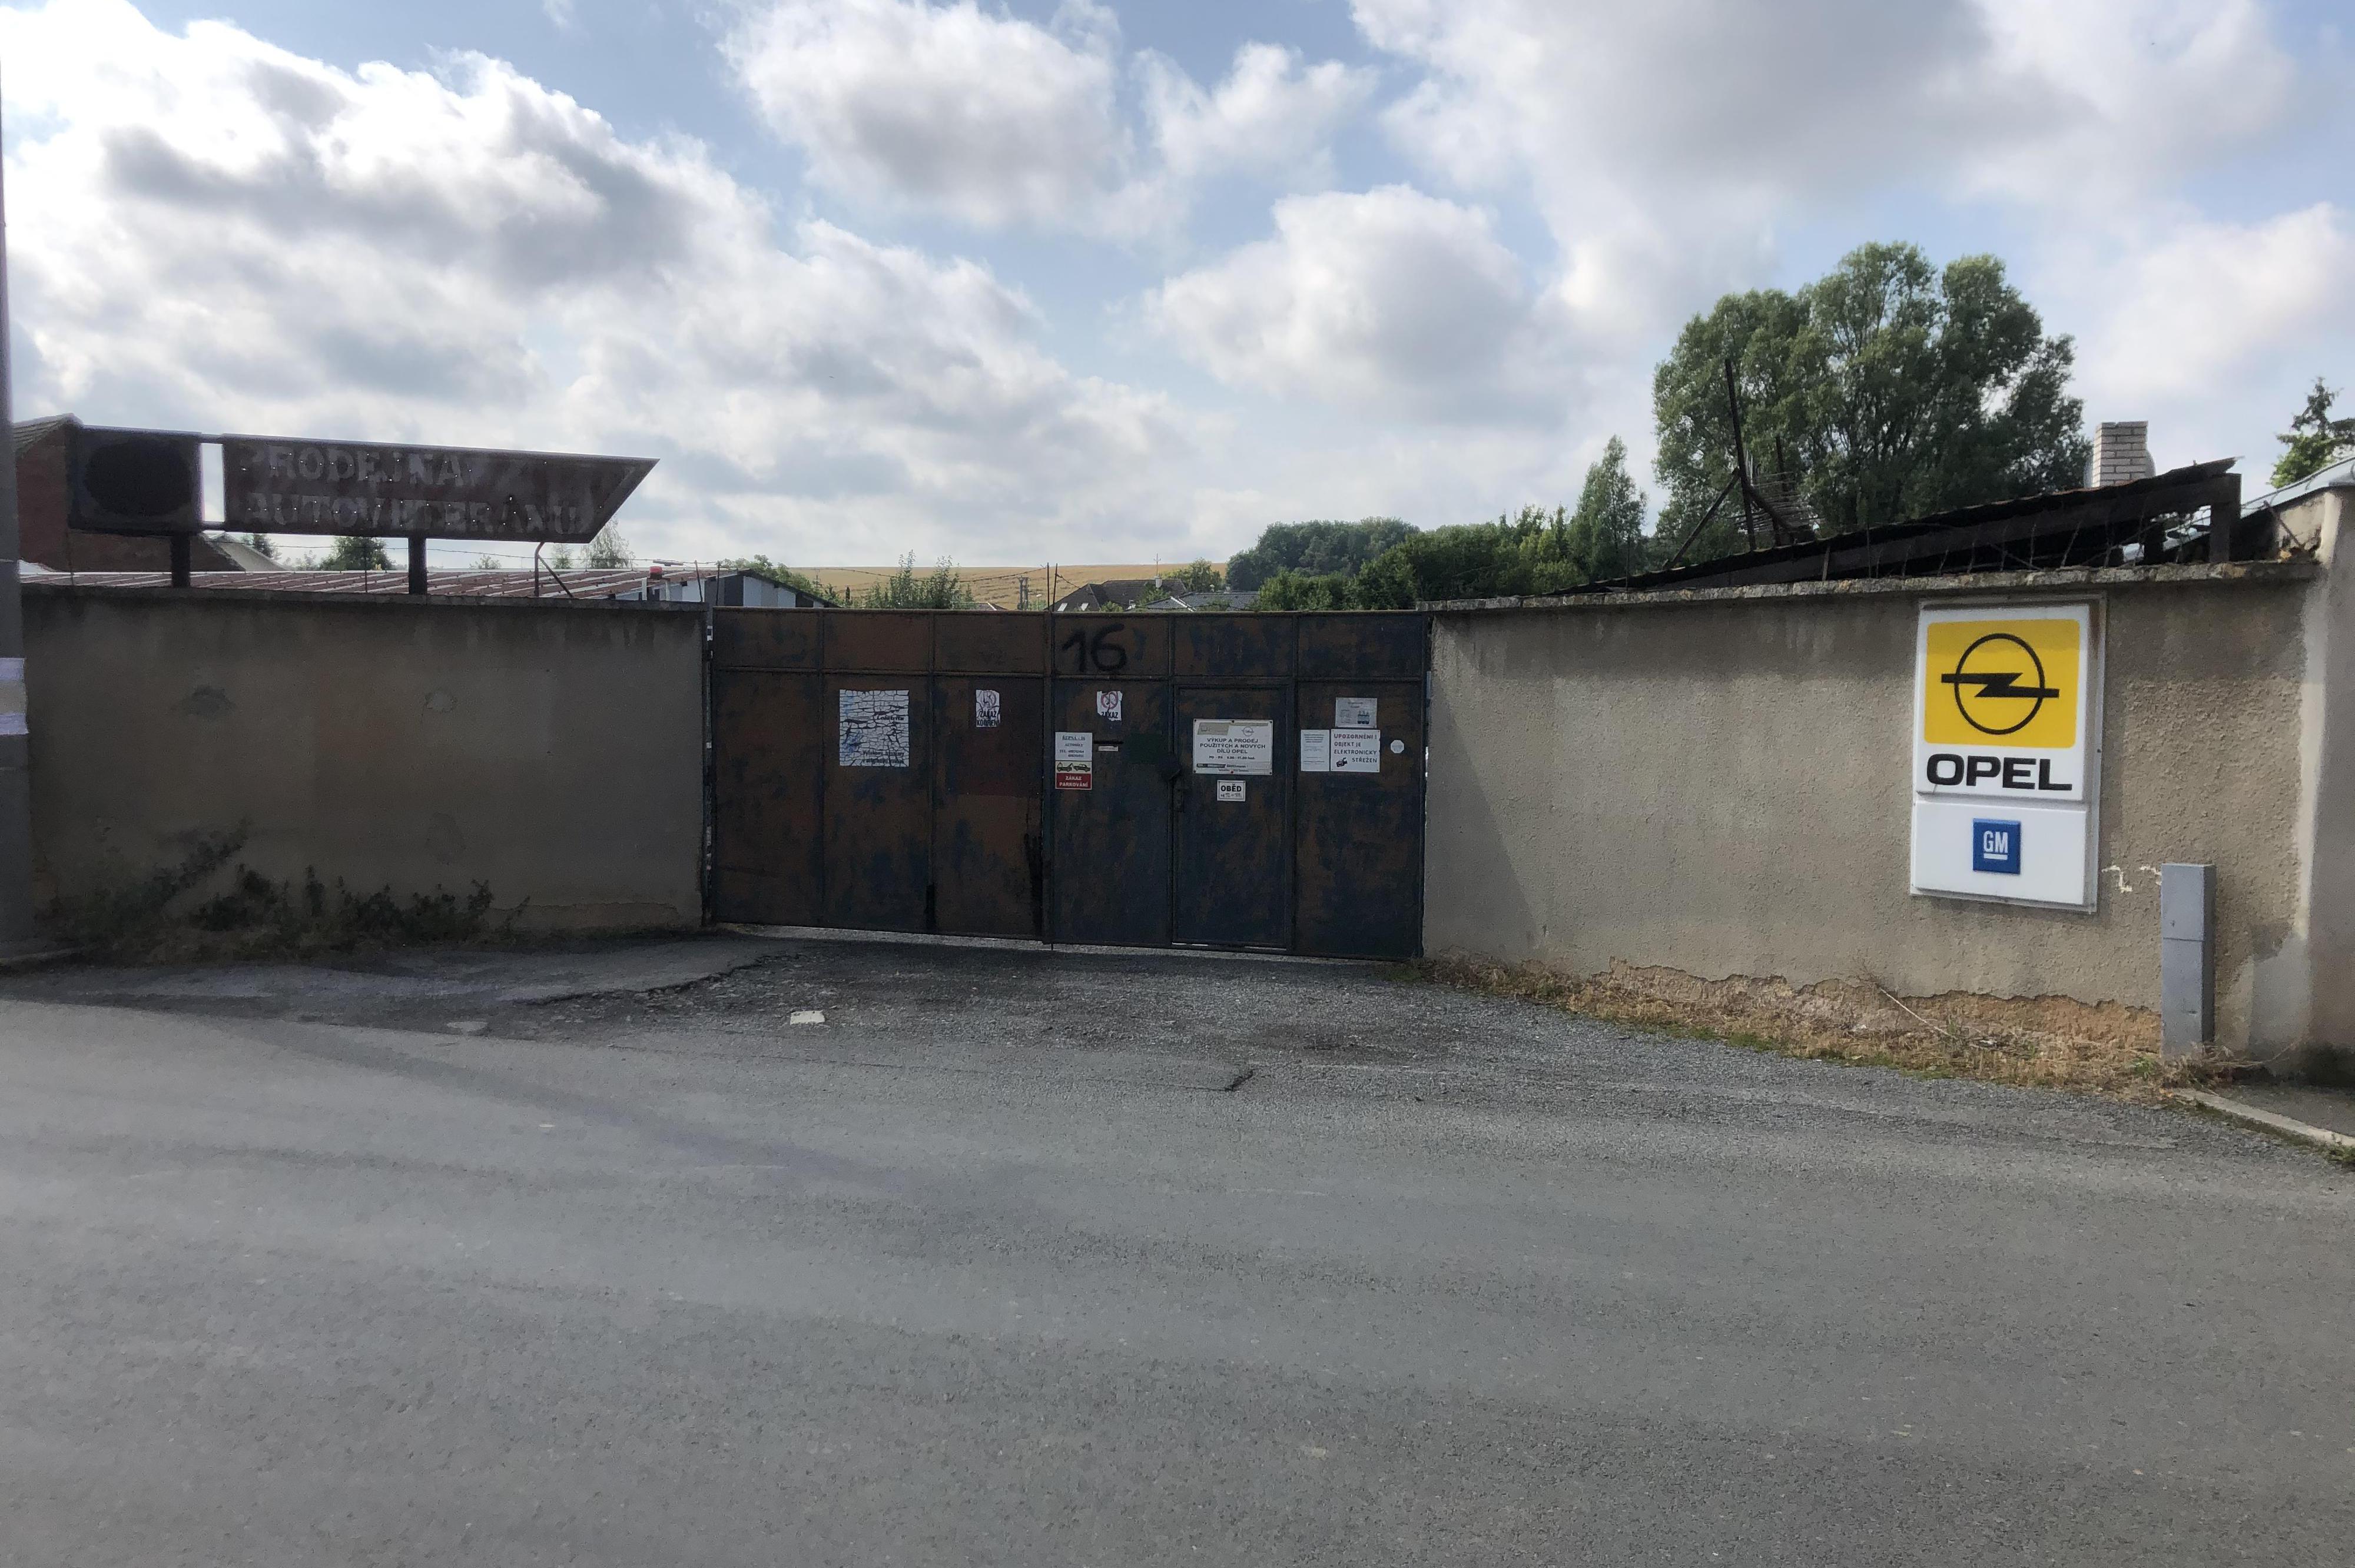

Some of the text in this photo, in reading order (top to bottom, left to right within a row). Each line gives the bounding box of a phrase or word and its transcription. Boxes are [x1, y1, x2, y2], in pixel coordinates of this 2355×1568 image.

[1062, 623, 1127, 672] 16
[1926, 753, 2072, 791] OPEL
[1220, 783, 1242, 792] OBĚD
[1983, 830, 2008, 853] GM
